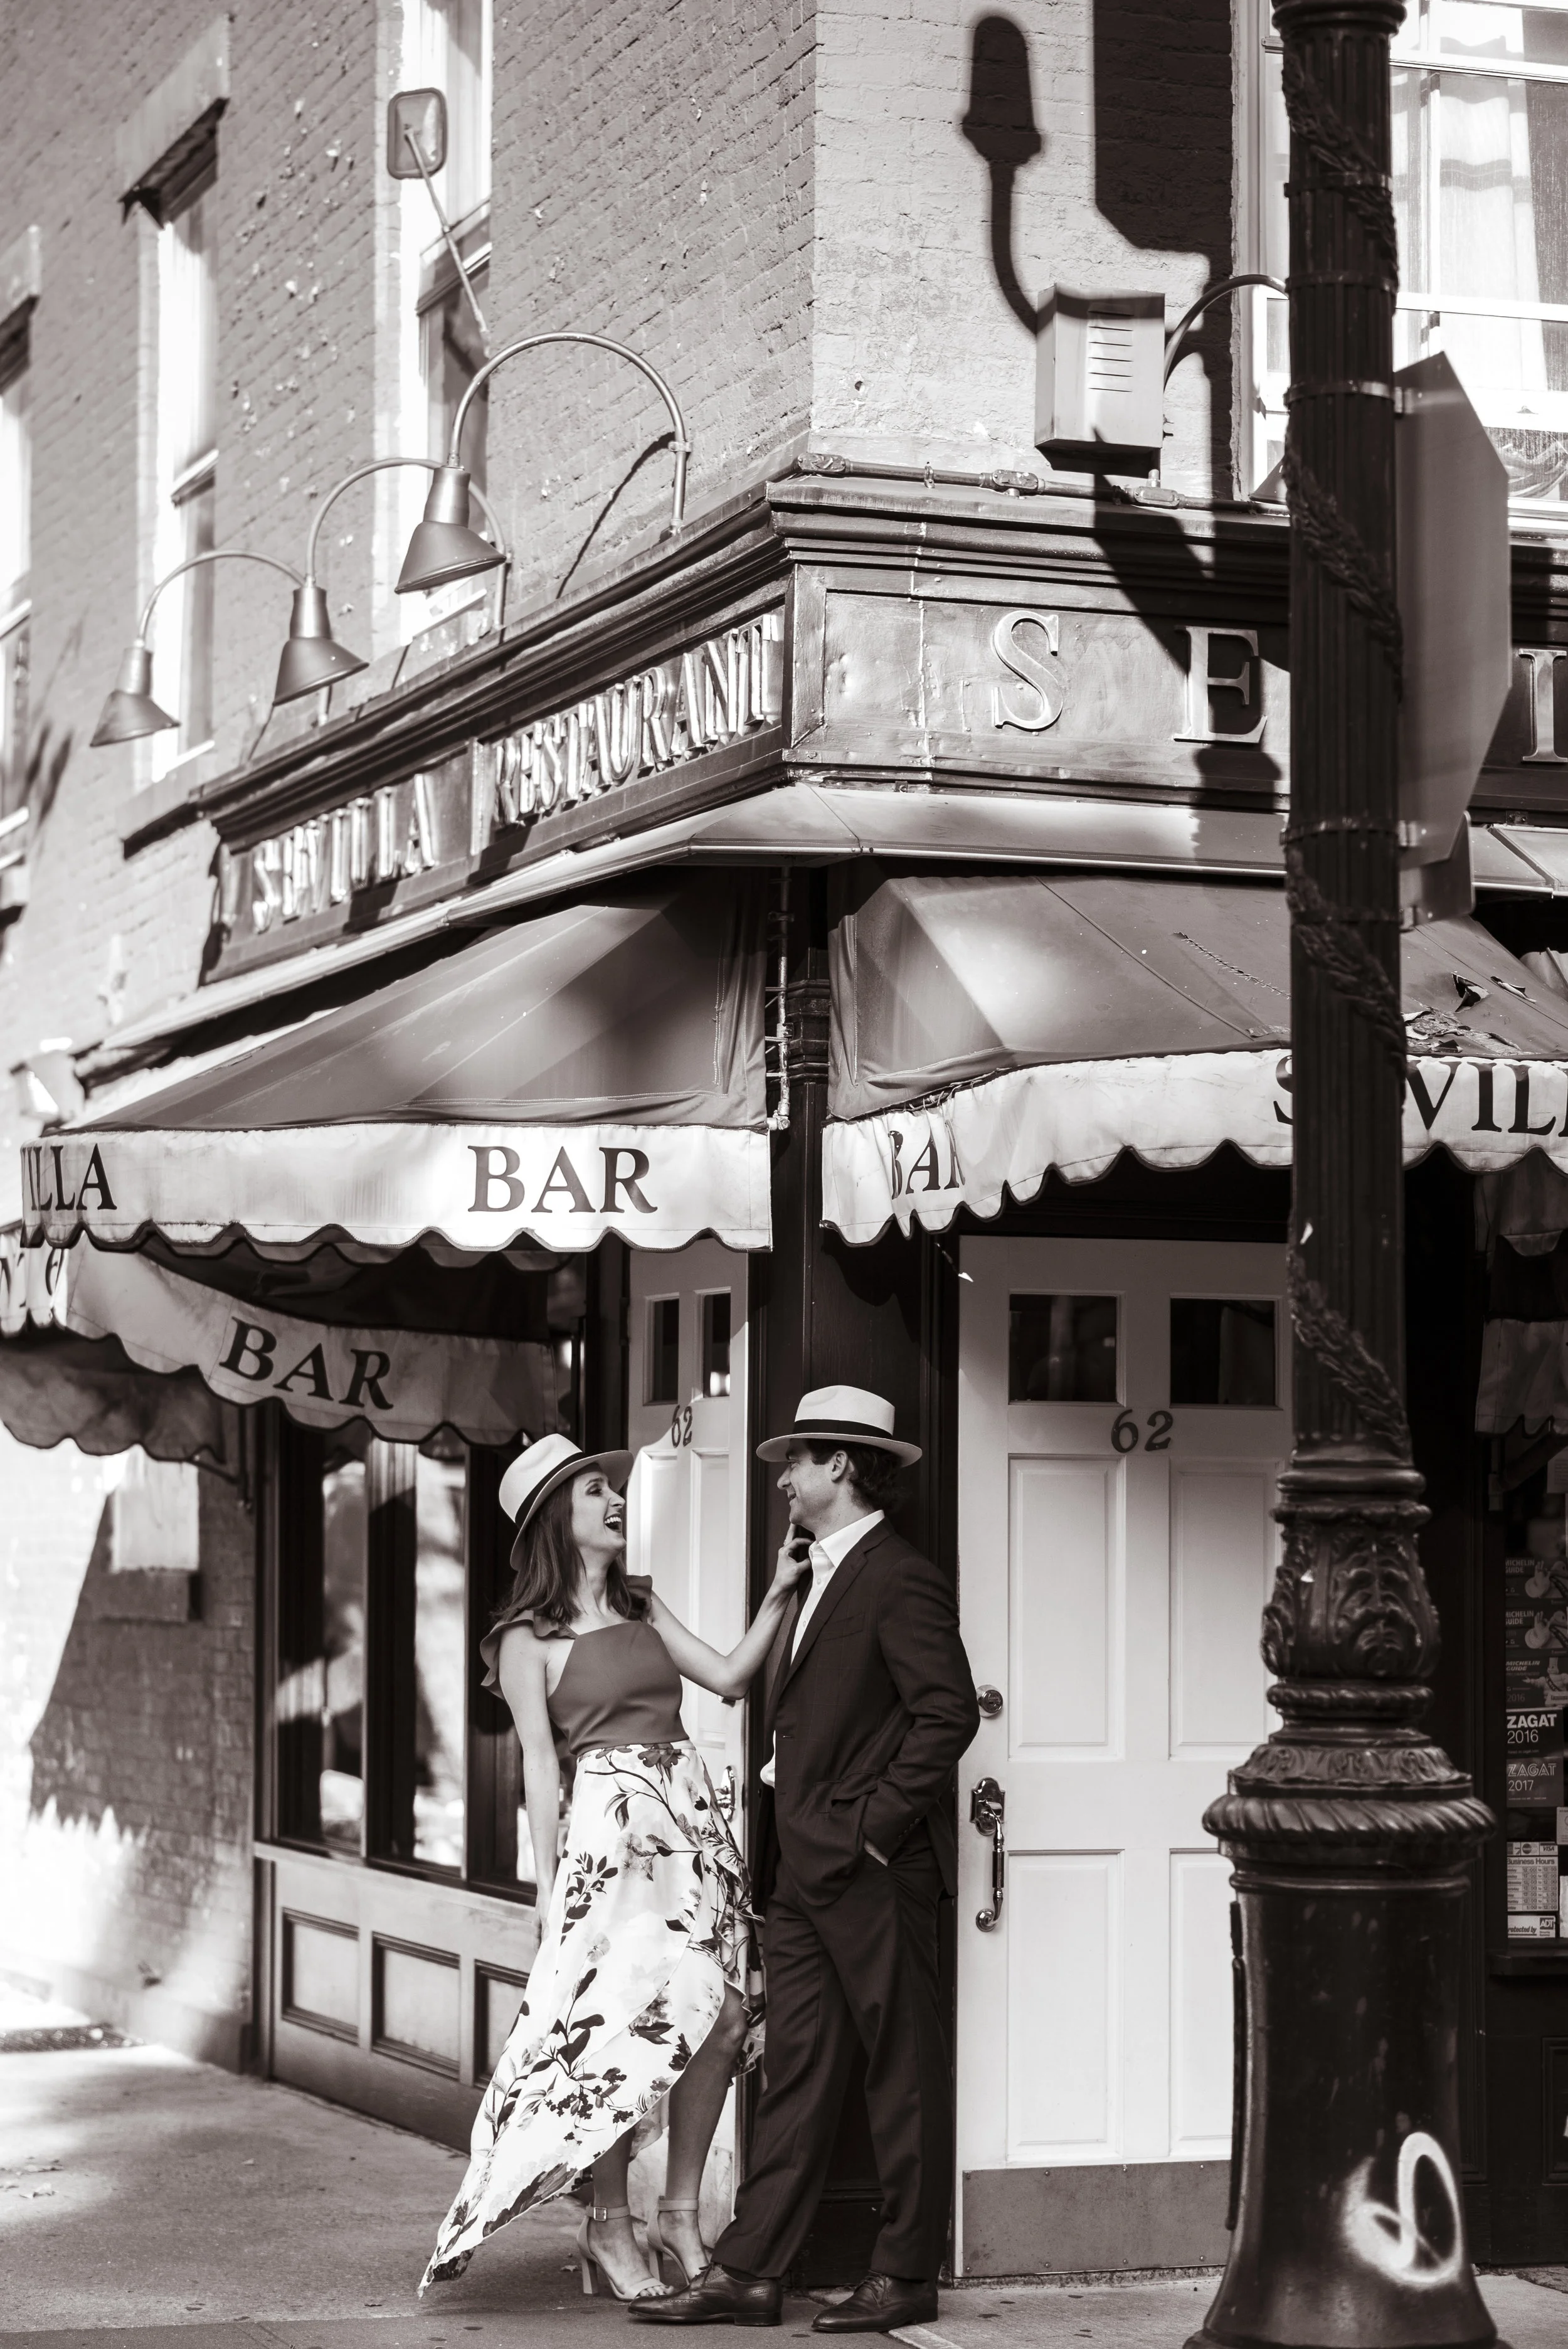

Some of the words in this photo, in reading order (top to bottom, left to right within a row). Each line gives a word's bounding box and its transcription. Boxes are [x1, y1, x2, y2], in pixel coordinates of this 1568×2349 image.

[253, 773, 438, 935] SEVILLA
[494, 614, 780, 827] RESTAURANT
[888, 1120, 965, 1200] BAR
[467, 1145, 658, 1214] BAR
[219, 1316, 394, 1410] BAR
[672, 1404, 692, 1448] 62
[1111, 1409, 1173, 1453] 62
[1507, 1694, 1525, 1702] 2016
[1507, 1714, 1557, 1729] ZAGAT
[1507, 1729, 1539, 1744] 2016
[1508, 1763, 1557, 1777] ZAGAT
[1508, 1779, 1534, 1791] 2017
[1540, 1919, 1554, 1927] ADT
